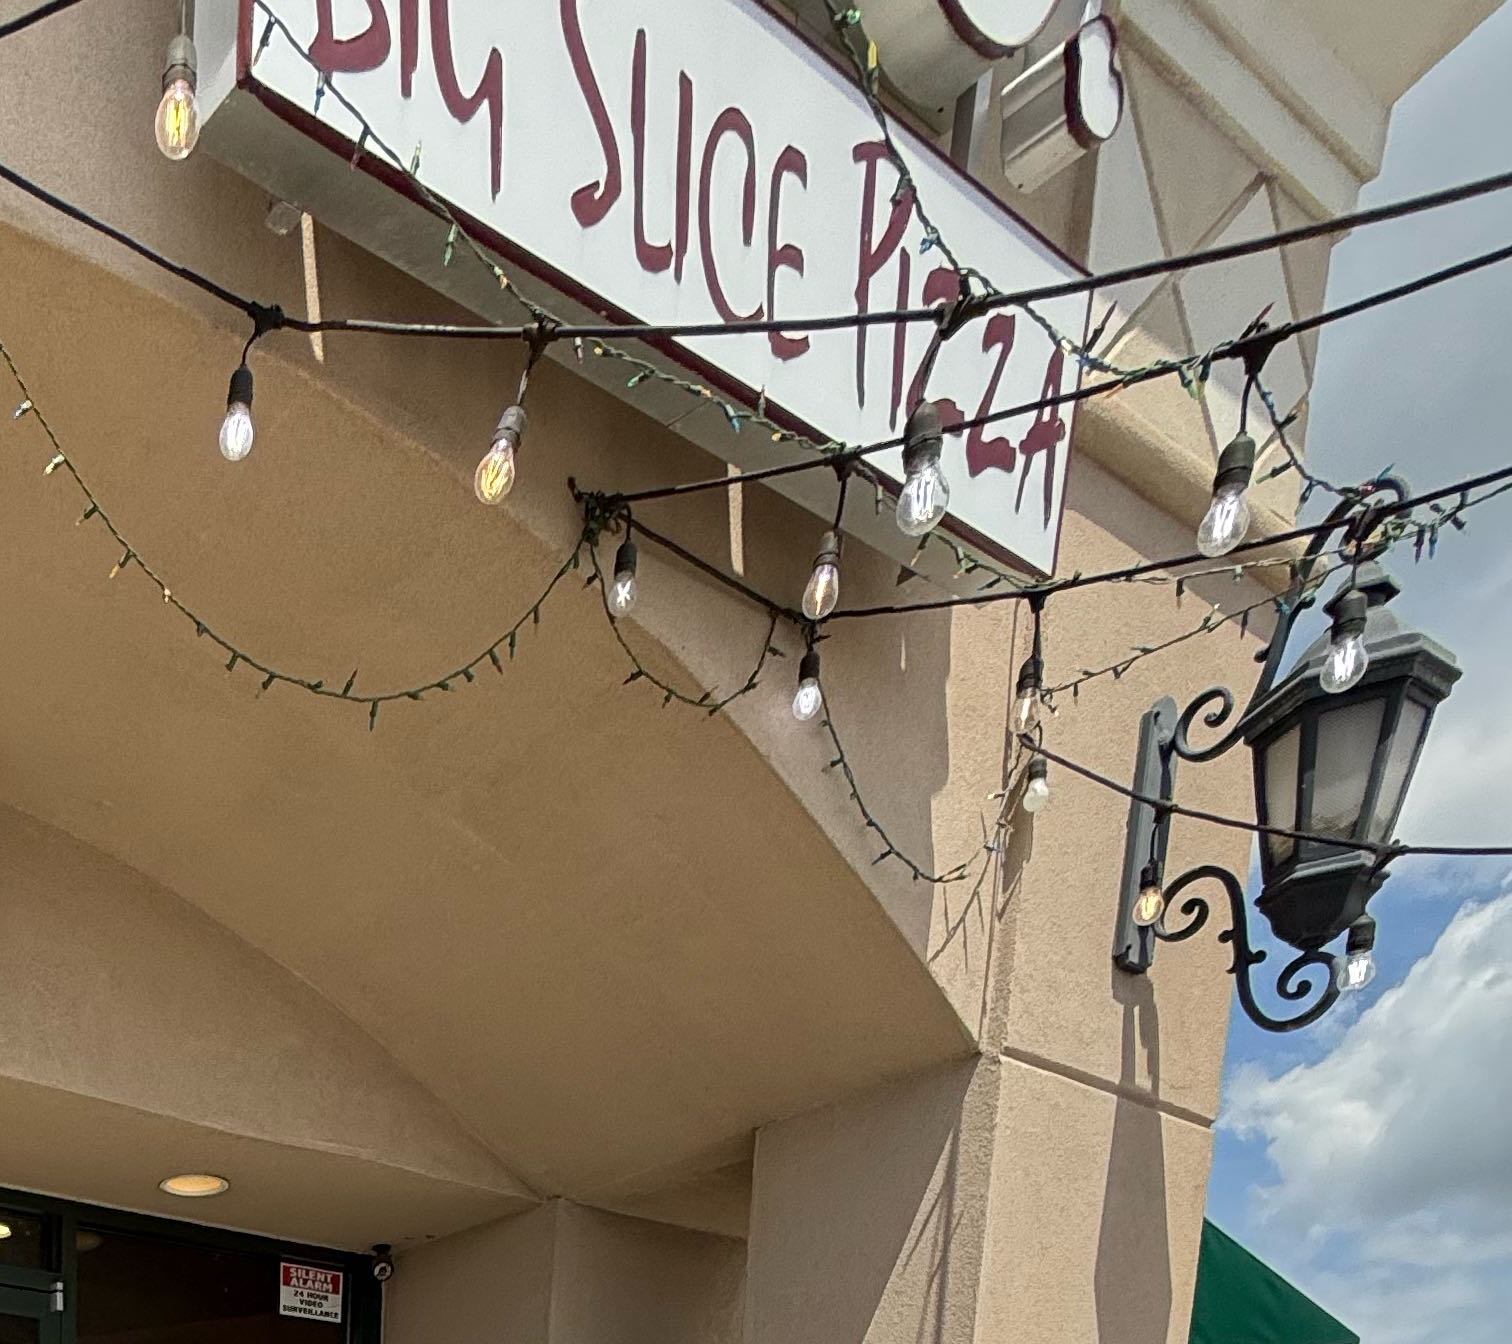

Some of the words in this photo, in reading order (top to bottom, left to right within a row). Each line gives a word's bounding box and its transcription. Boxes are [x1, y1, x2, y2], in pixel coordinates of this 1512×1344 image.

[309, 0, 503, 204] IG
[560, 0, 811, 362] SLICE
[853, 140, 1066, 531] PIZZA
[289, 1267, 333, 1283] SILENT
[290, 1277, 333, 1293] ALARM
[299, 1298, 324, 1309] VIDEO
